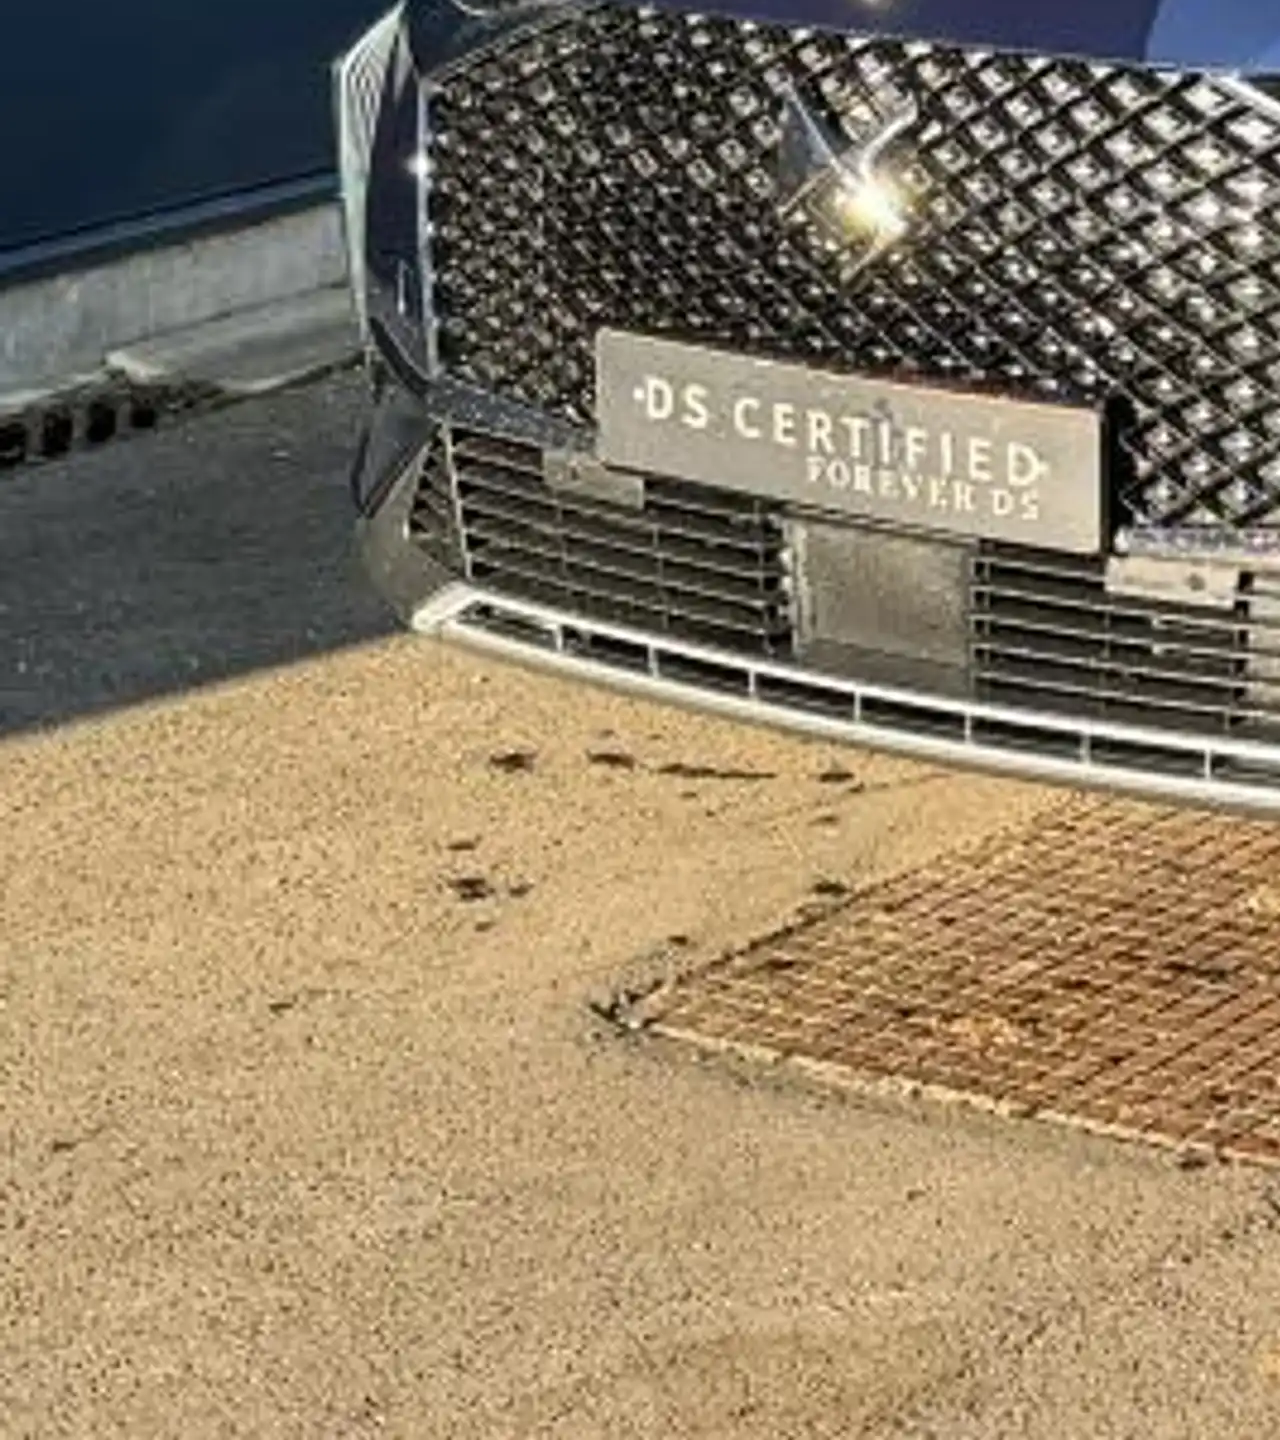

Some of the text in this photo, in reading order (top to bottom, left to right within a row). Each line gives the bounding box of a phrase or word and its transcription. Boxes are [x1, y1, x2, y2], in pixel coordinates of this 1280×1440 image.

[733, 396, 1041, 487] CERTIFIED
[806, 456, 1040, 521] FOREVER DS
